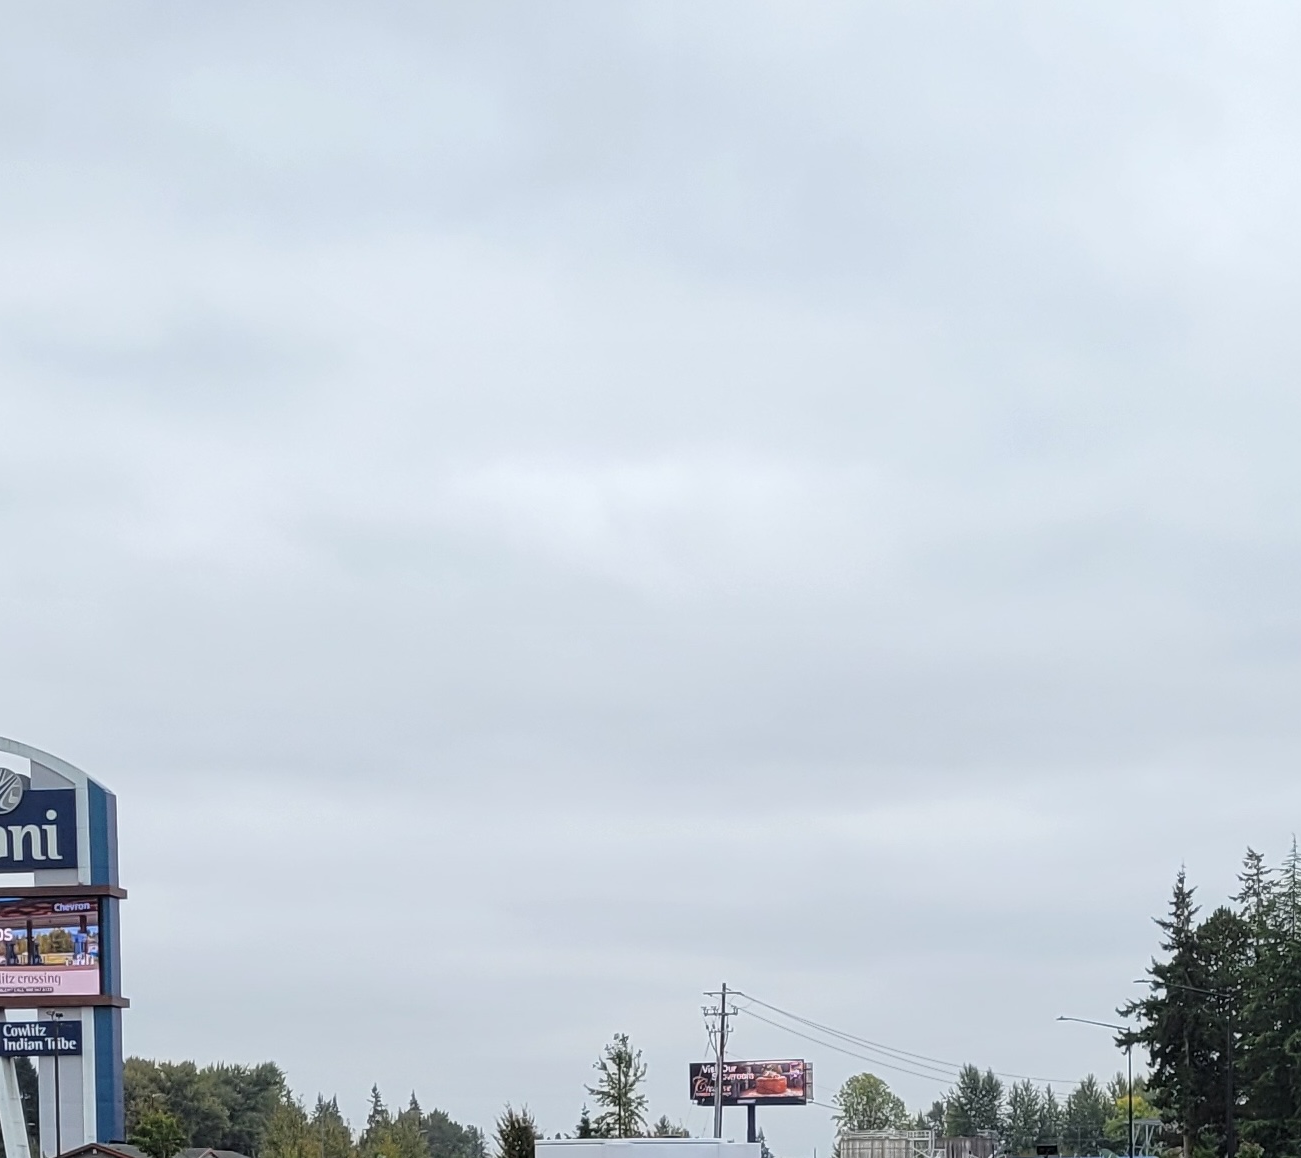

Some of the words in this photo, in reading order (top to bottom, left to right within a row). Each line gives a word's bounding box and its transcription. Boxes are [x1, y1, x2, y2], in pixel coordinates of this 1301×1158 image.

[54, 902, 91, 912] Chevron
[17, 972, 61, 986] crossing
[3, 1024, 47, 1037] Cowlitz
[3, 1038, 44, 1051] Indian
